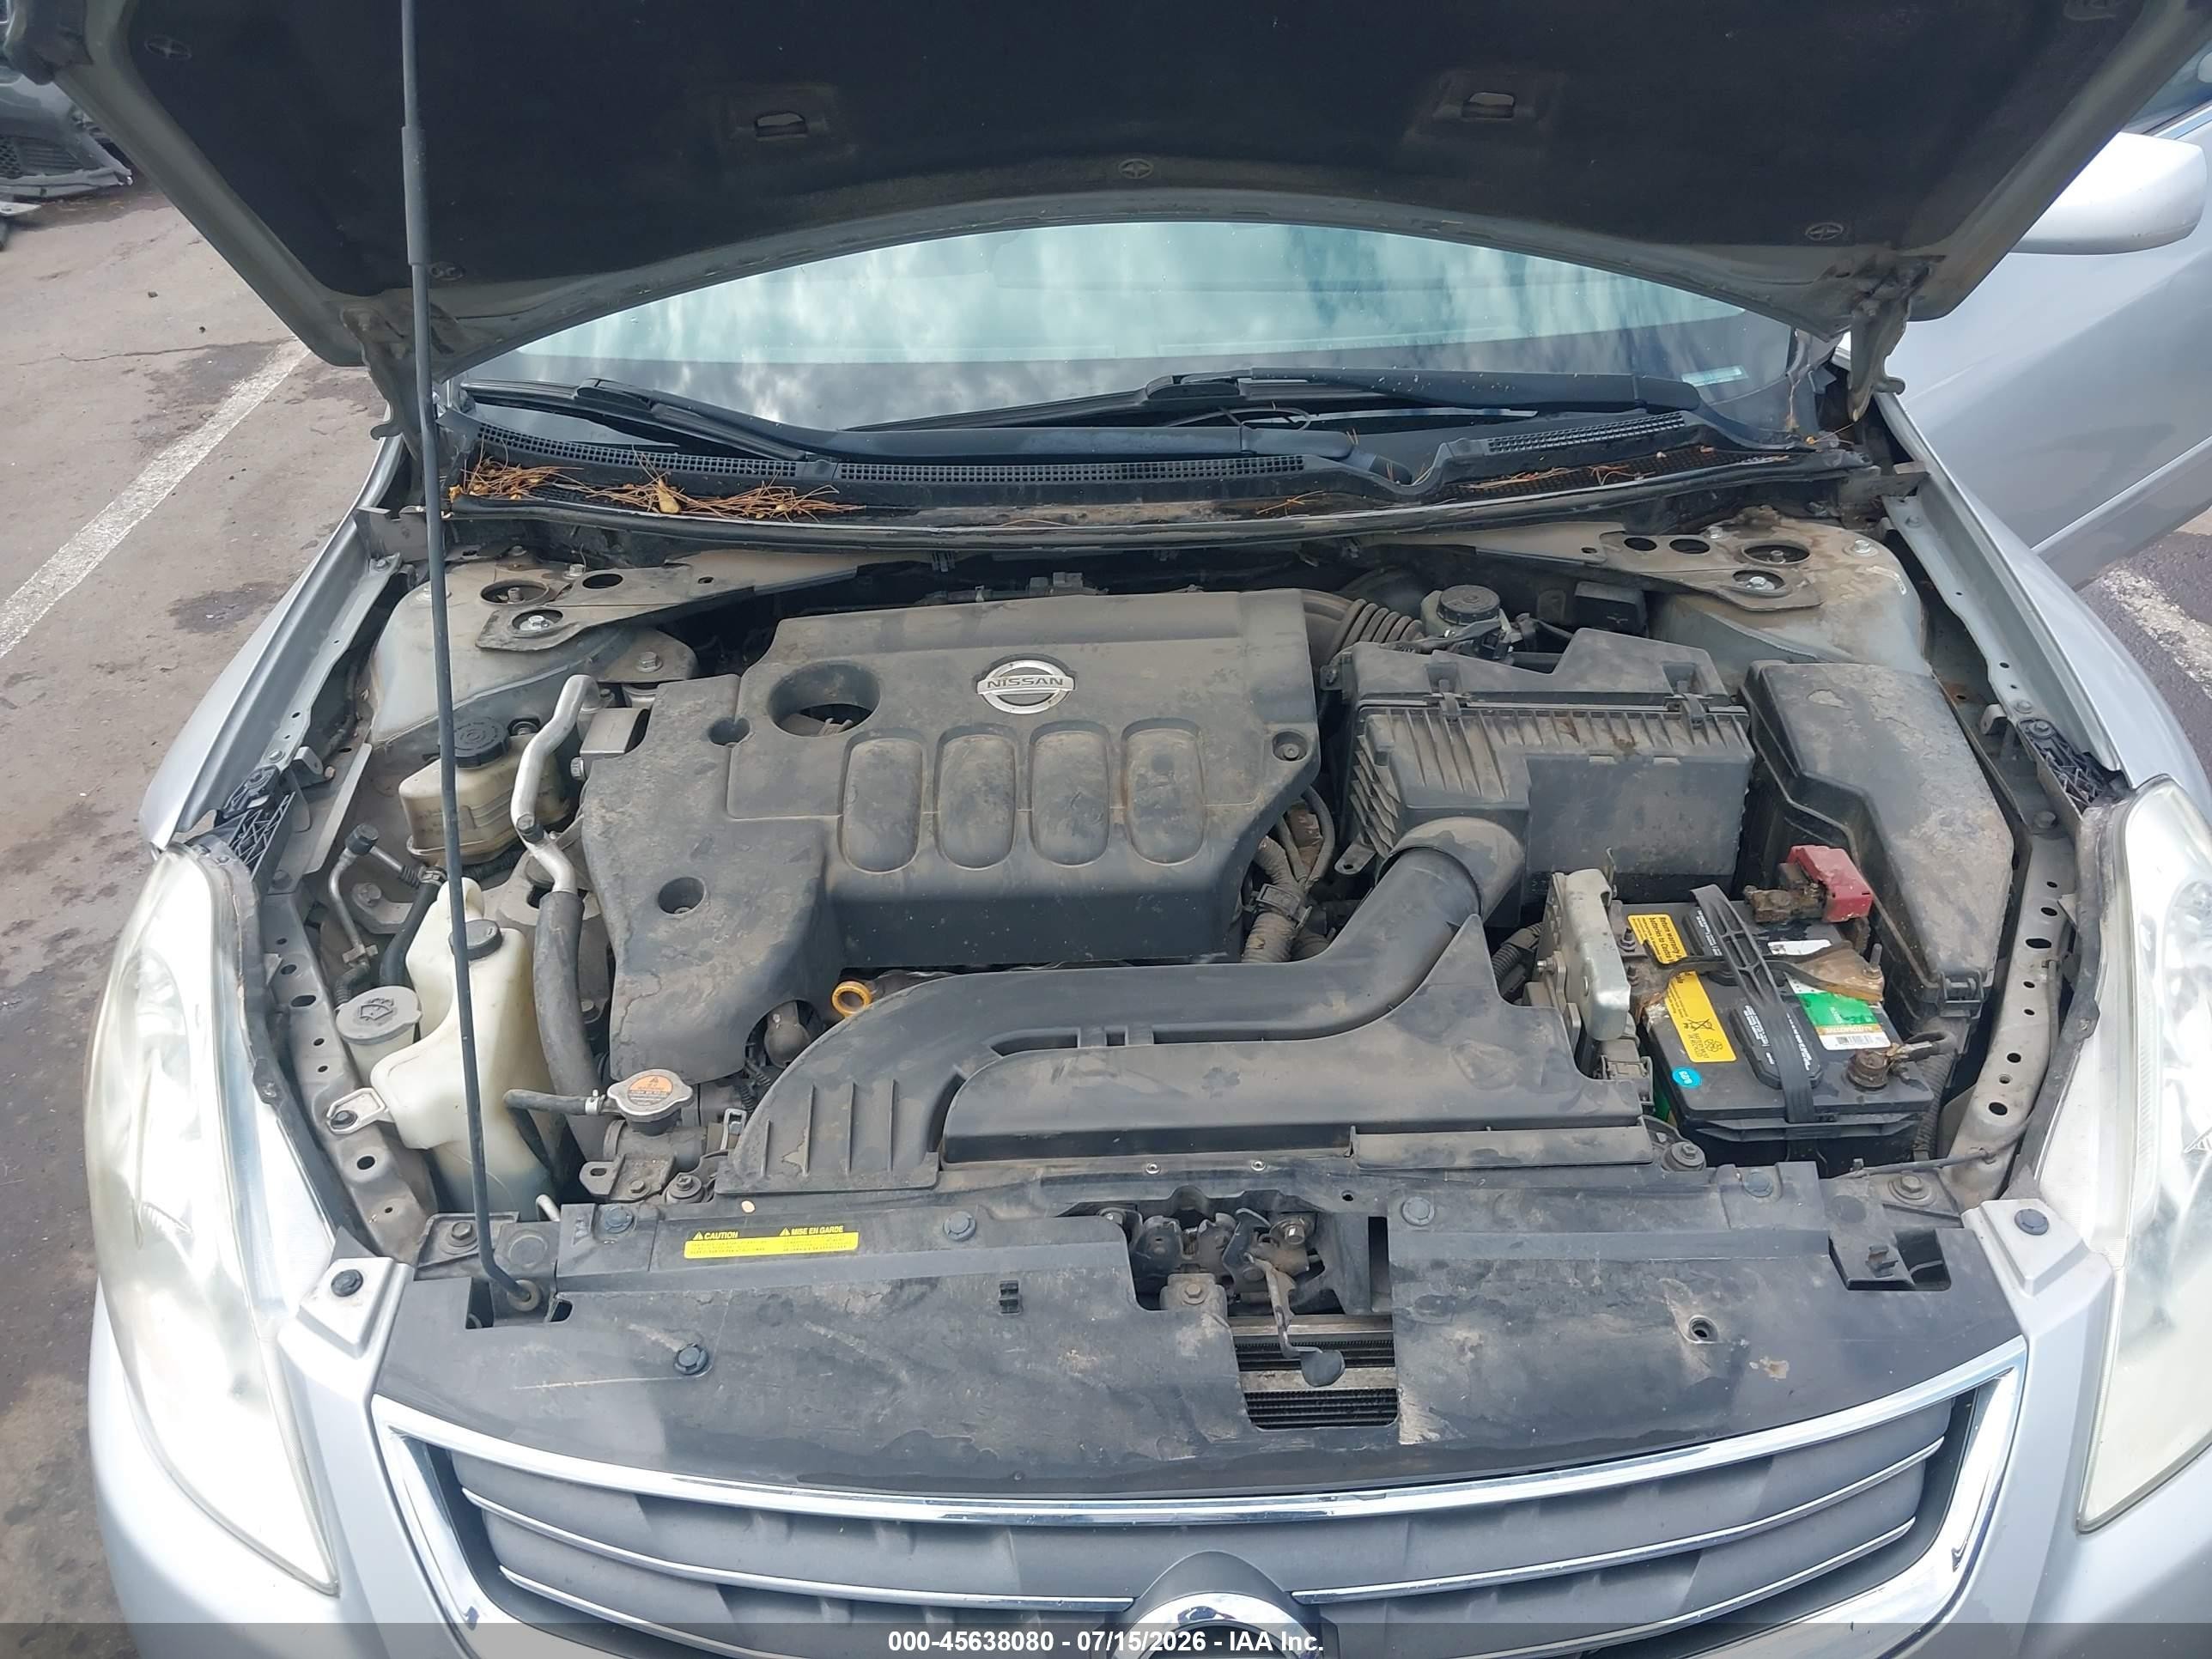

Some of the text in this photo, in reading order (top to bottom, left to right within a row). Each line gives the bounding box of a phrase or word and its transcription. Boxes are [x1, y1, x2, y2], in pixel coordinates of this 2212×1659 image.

[988, 677, 1063, 688] NISSAN
[704, 1231, 738, 1240] CAUTION
[791, 1225, 844, 1236] MISE EN GARDE
